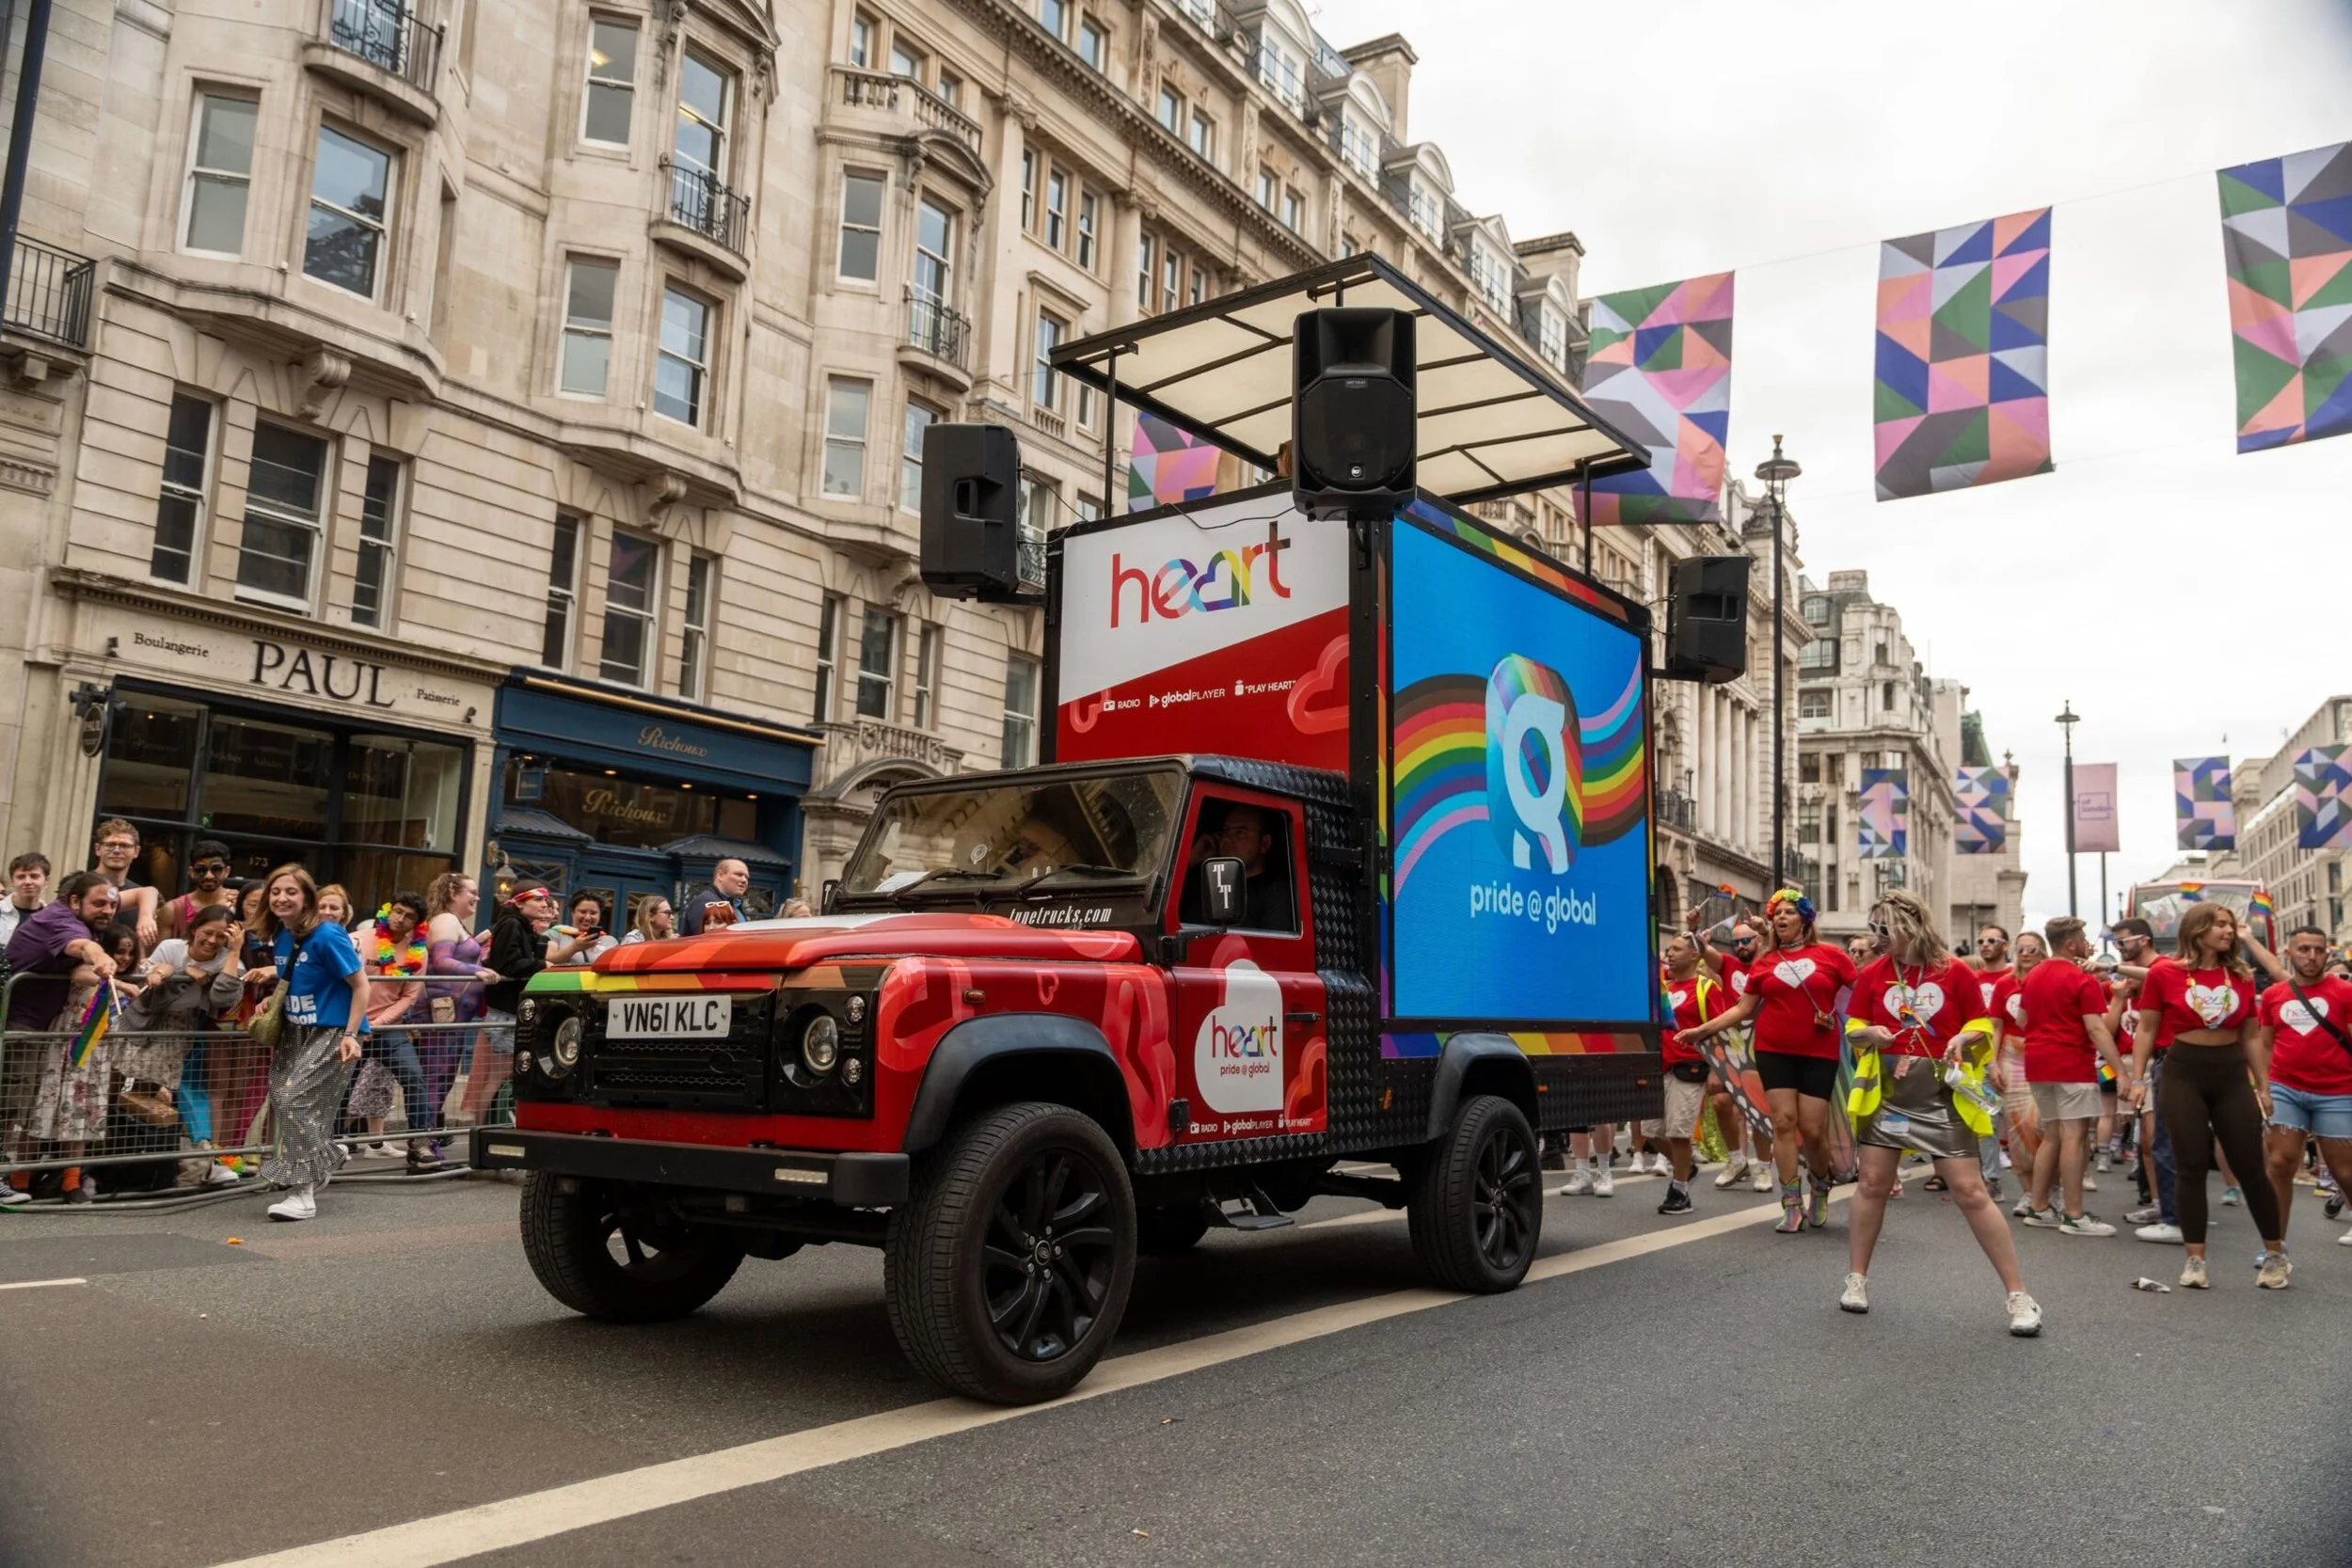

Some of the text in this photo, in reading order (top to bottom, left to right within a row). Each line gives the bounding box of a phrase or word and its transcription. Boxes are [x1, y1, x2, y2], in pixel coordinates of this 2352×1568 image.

[1110, 521, 1291, 628] heart
[133, 632, 210, 658] Boulangerie
[249, 640, 397, 709] PAUL
[416, 688, 461, 707] Patisserie
[1117, 698, 1141, 710] RADIO
[637, 725, 708, 757] Richoux
[581, 788, 672, 823] Richoux
[248, 855, 269, 868] 173
[1470, 880, 1597, 935] pride @ global
[624, 1000, 719, 1033] VN61 KLC
[1212, 1015, 1278, 1058] heart
[1220, 1064, 1241, 1077] pride
[1248, 1061, 1270, 1079] global
